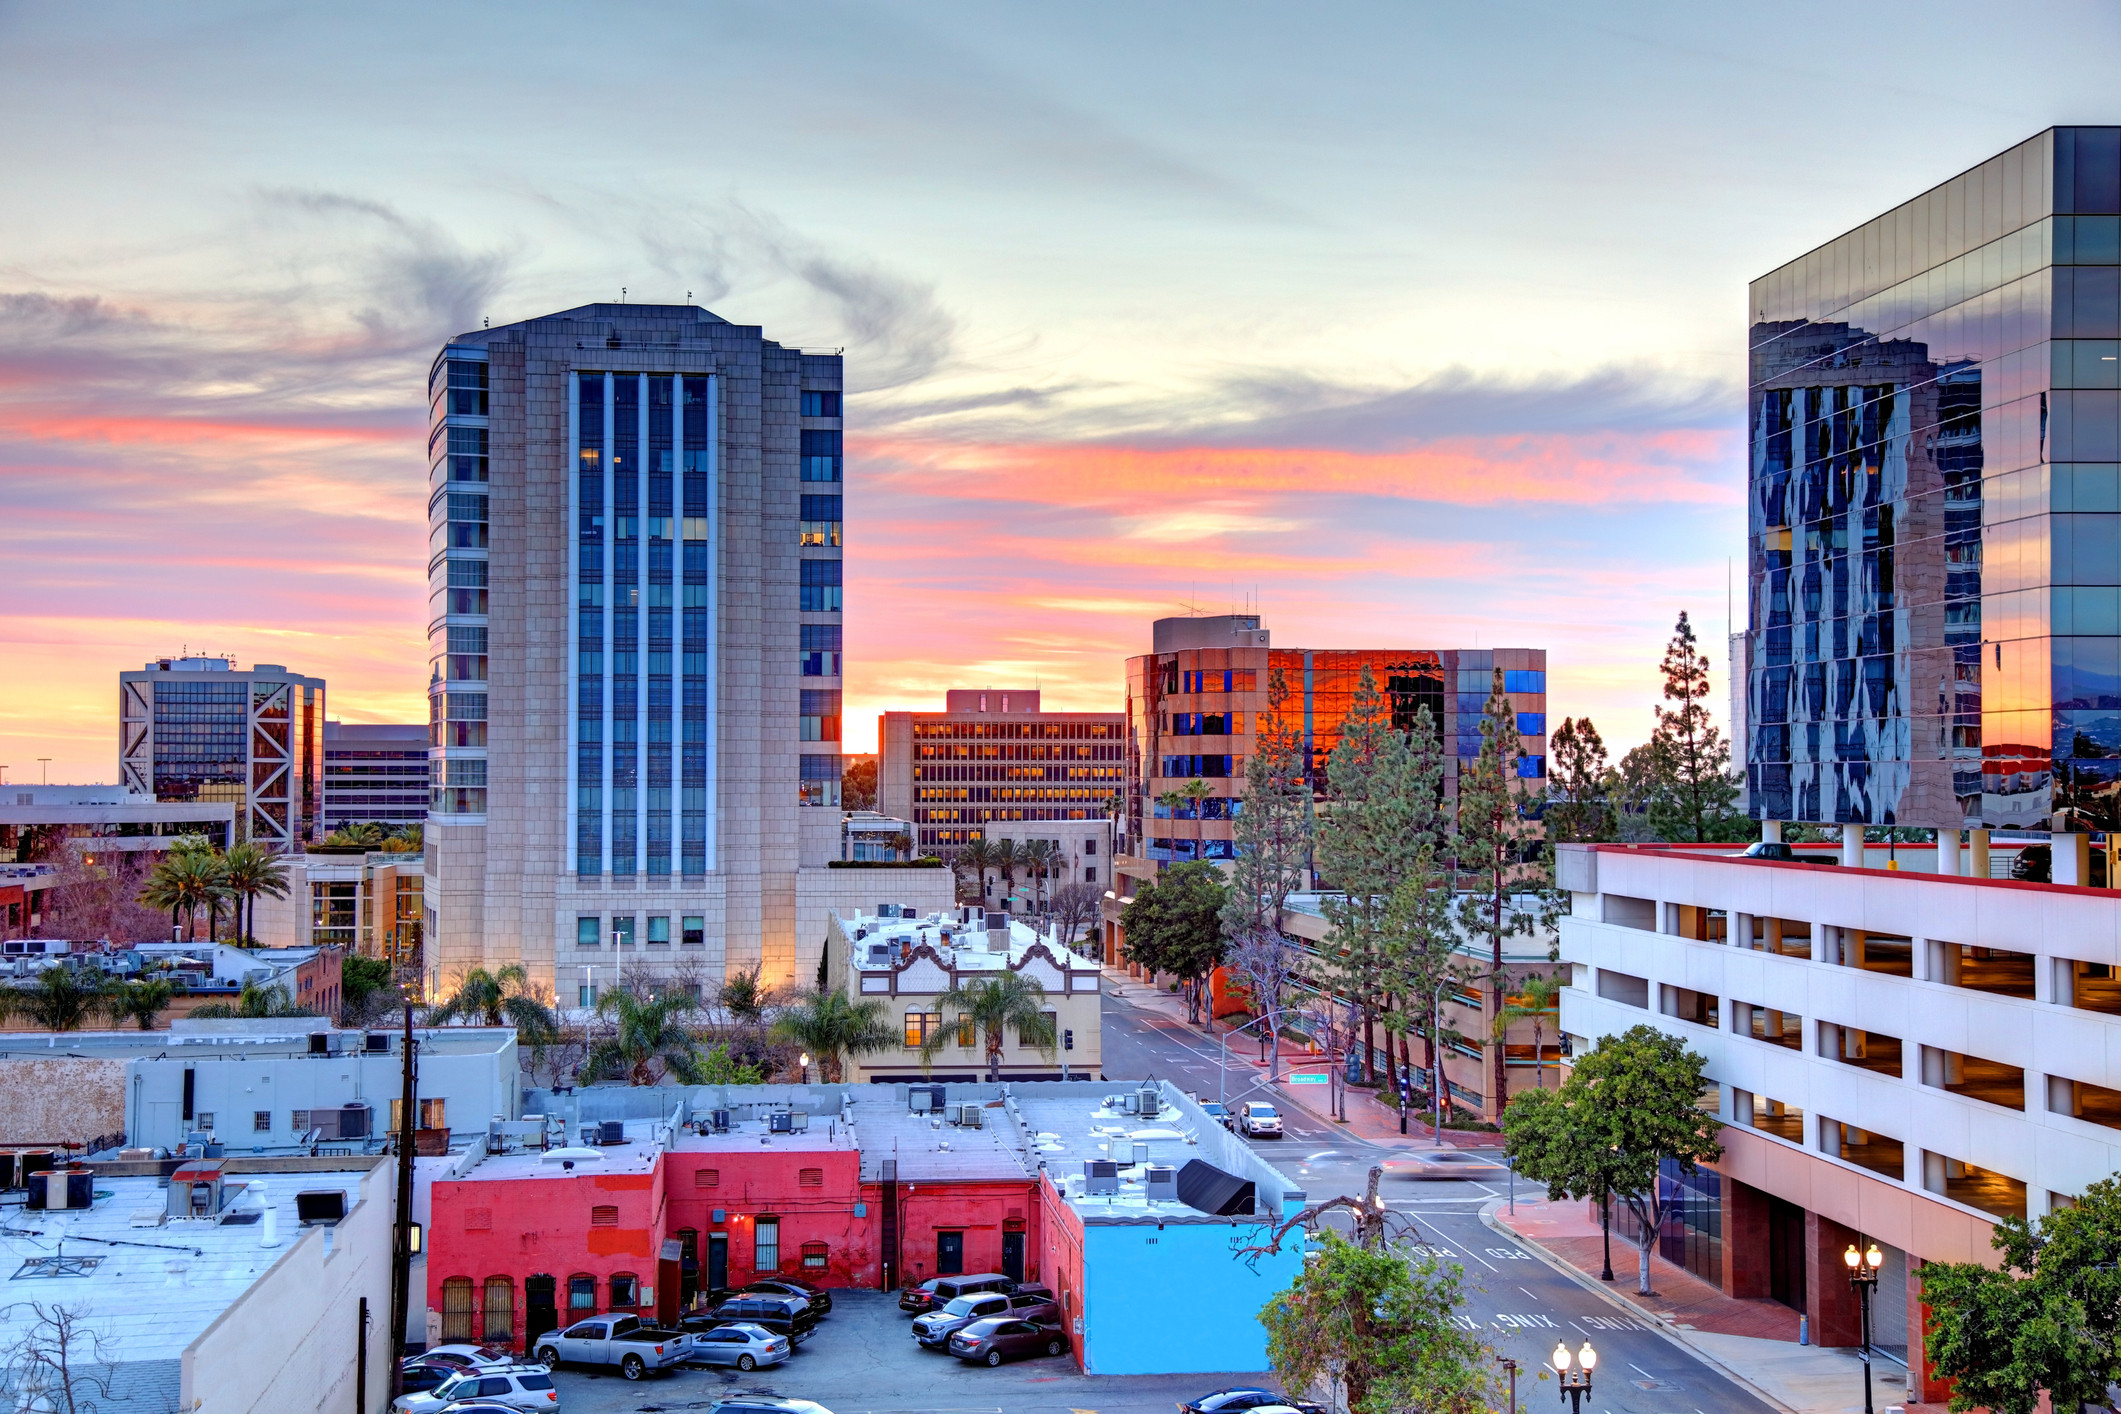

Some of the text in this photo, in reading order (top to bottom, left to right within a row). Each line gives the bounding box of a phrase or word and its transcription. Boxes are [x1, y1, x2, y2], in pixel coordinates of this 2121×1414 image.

[1485, 1248, 1532, 1260] PED
[1496, 1313, 1560, 1328] XING
[1581, 1315, 1647, 1331] XING
